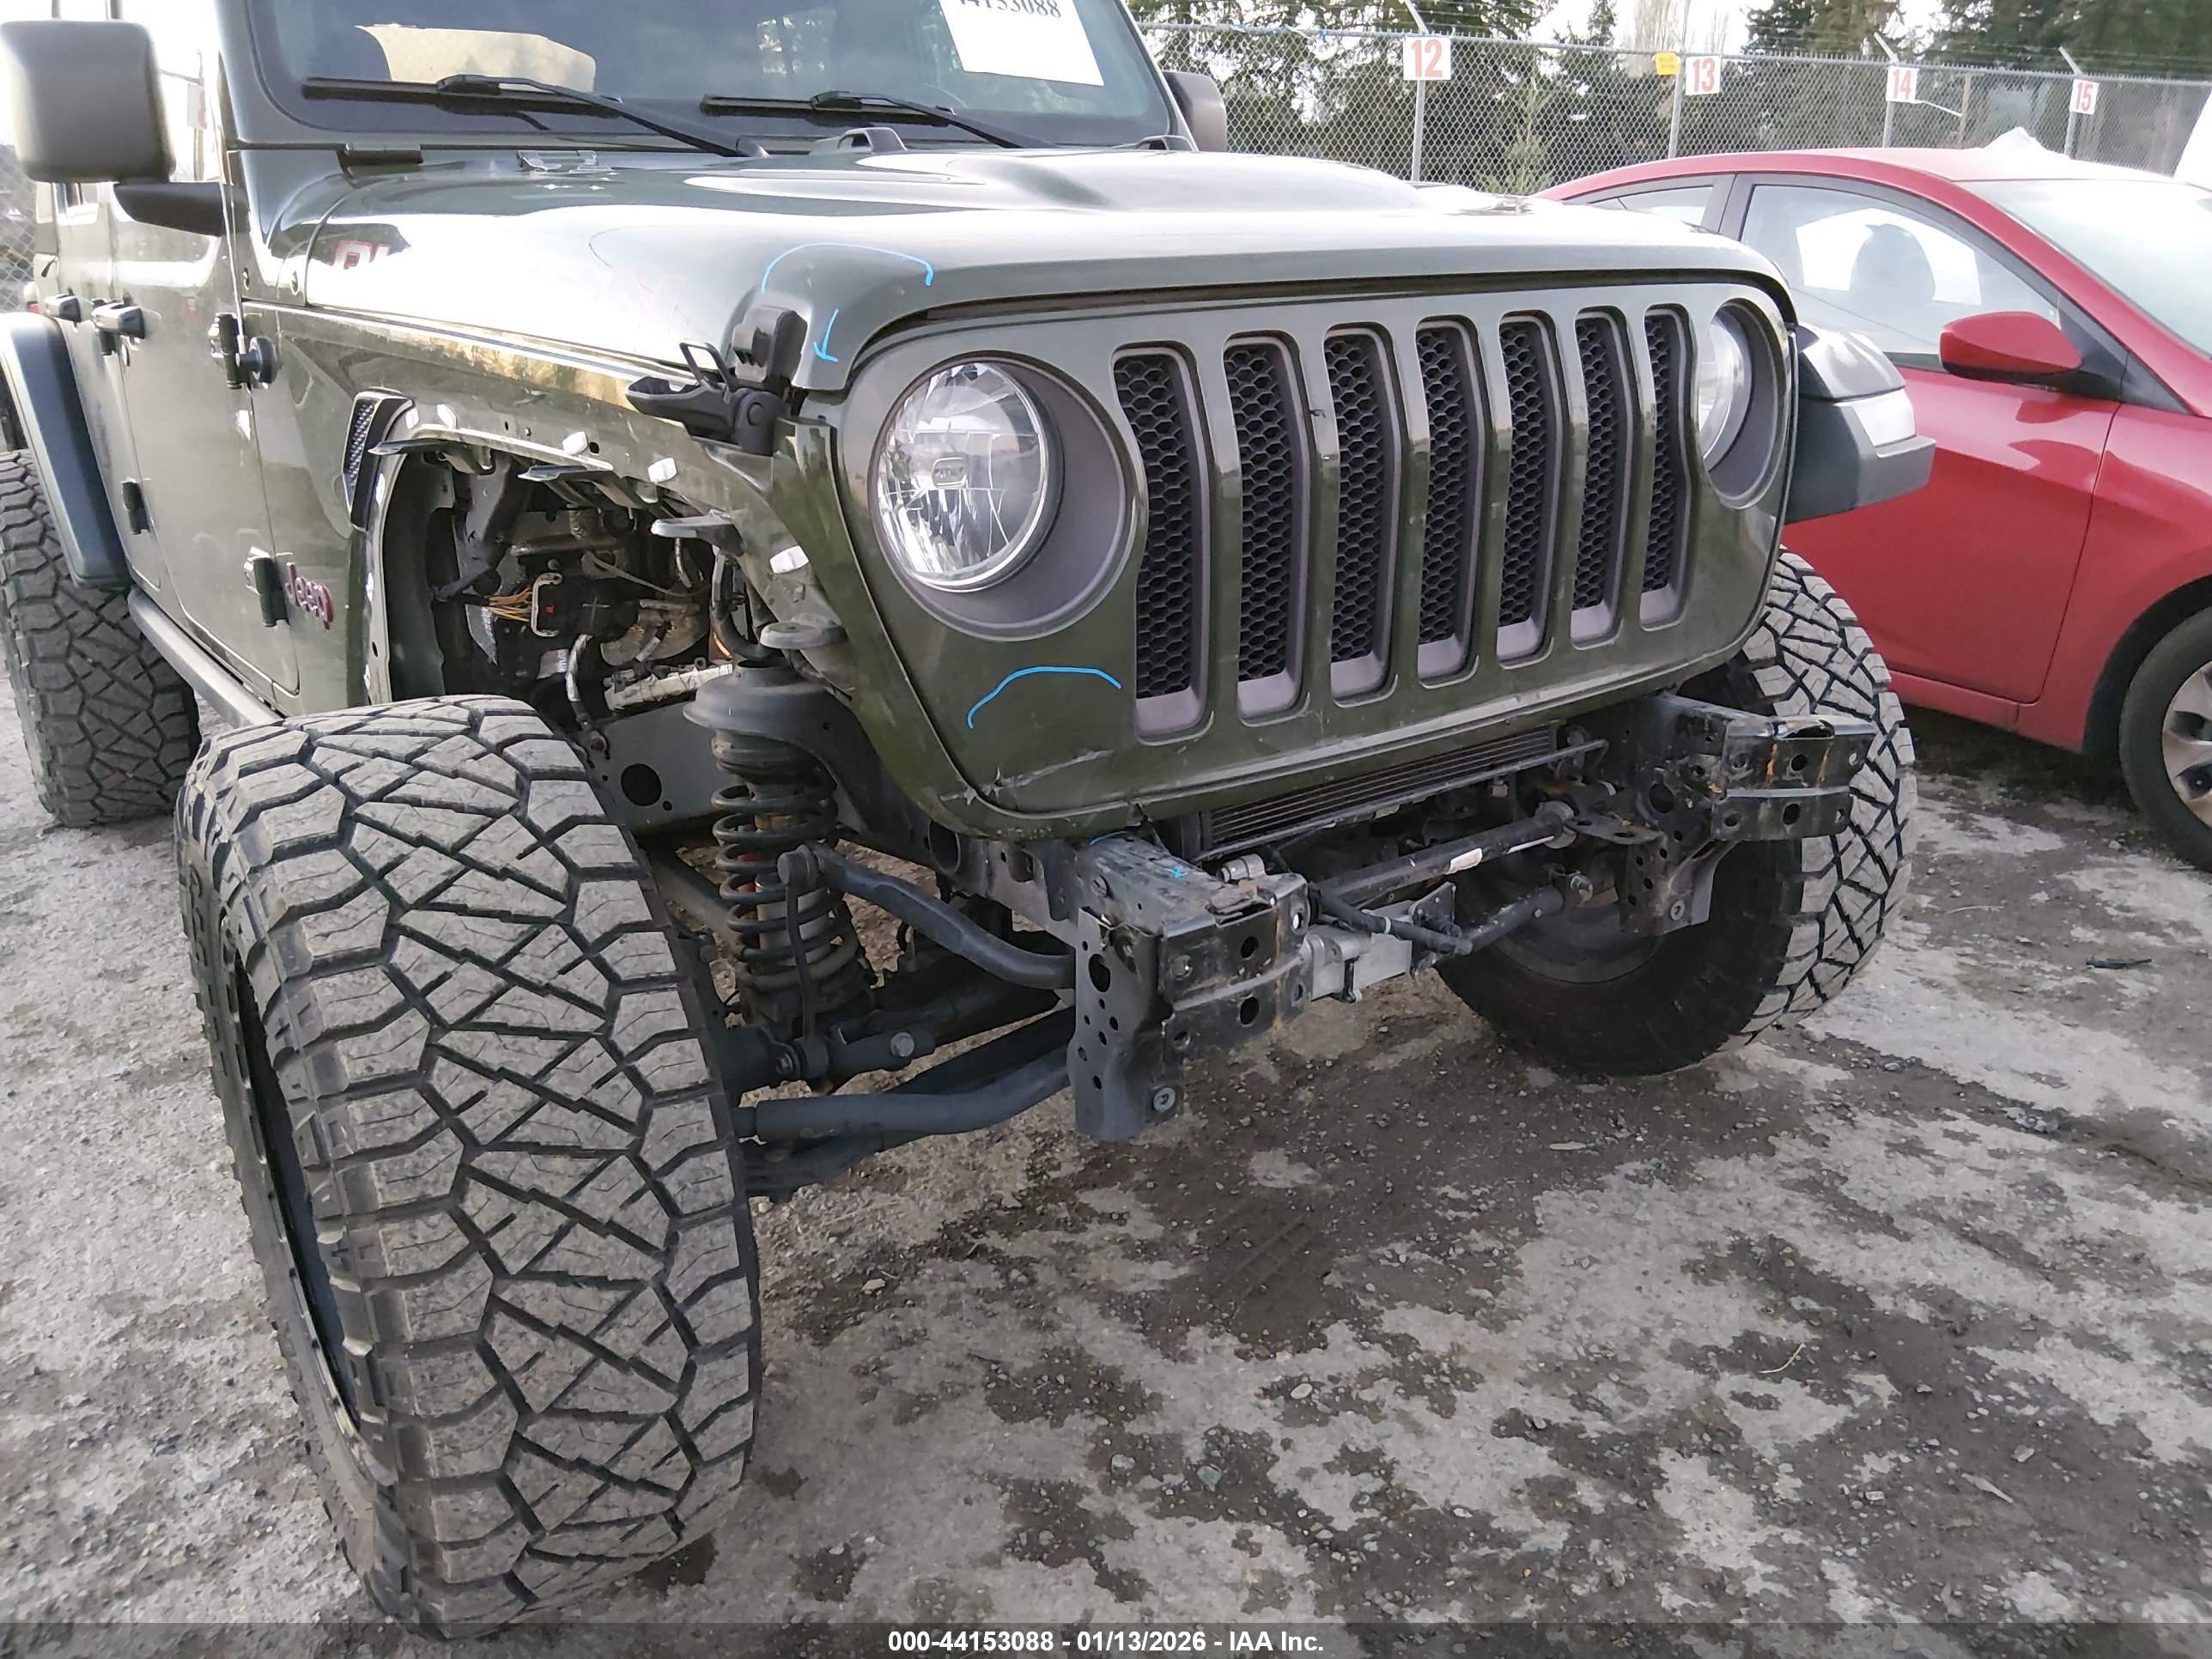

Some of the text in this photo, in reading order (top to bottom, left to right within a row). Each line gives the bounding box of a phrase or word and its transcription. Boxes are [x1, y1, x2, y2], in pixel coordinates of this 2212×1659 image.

[960, 0, 1061, 18] 53088
[1411, 39, 1443, 77] 12
[1692, 58, 1716, 93] 13
[1892, 67, 1912, 100] 14
[2075, 82, 2094, 112] 15
[284, 562, 334, 630] Jeep
